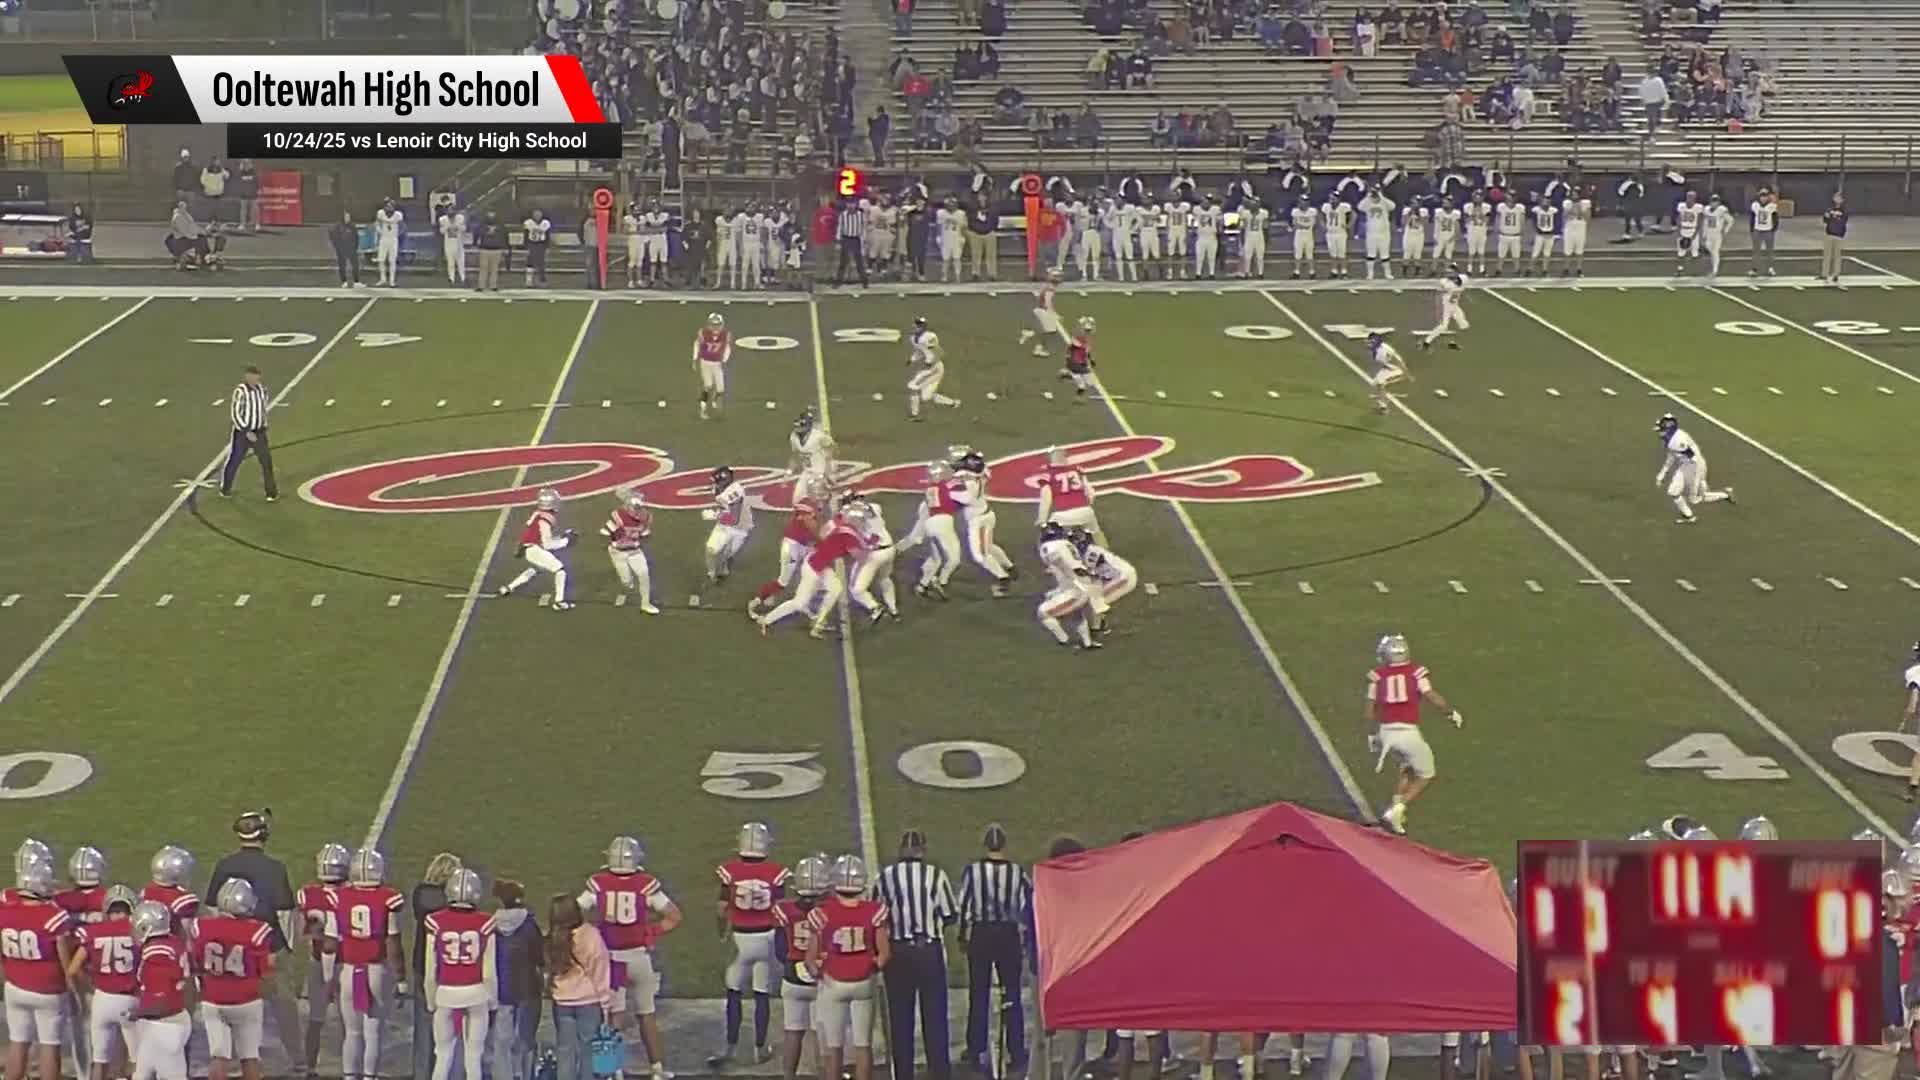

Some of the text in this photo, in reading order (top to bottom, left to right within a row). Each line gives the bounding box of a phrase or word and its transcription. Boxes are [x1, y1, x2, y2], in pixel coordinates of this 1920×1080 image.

[838, 170, 859, 196] 2
[1055, 473, 1083, 494] 73
[1386, 673, 1409, 704] 11
[350, 904, 372, 938] 9
[604, 890, 638, 924] 18
[1, 927, 42, 960] 68
[94, 936, 135, 974] 75
[441, 930, 481, 965] 33
[831, 925, 867, 955] 41
[203, 941, 245, 977] 64
